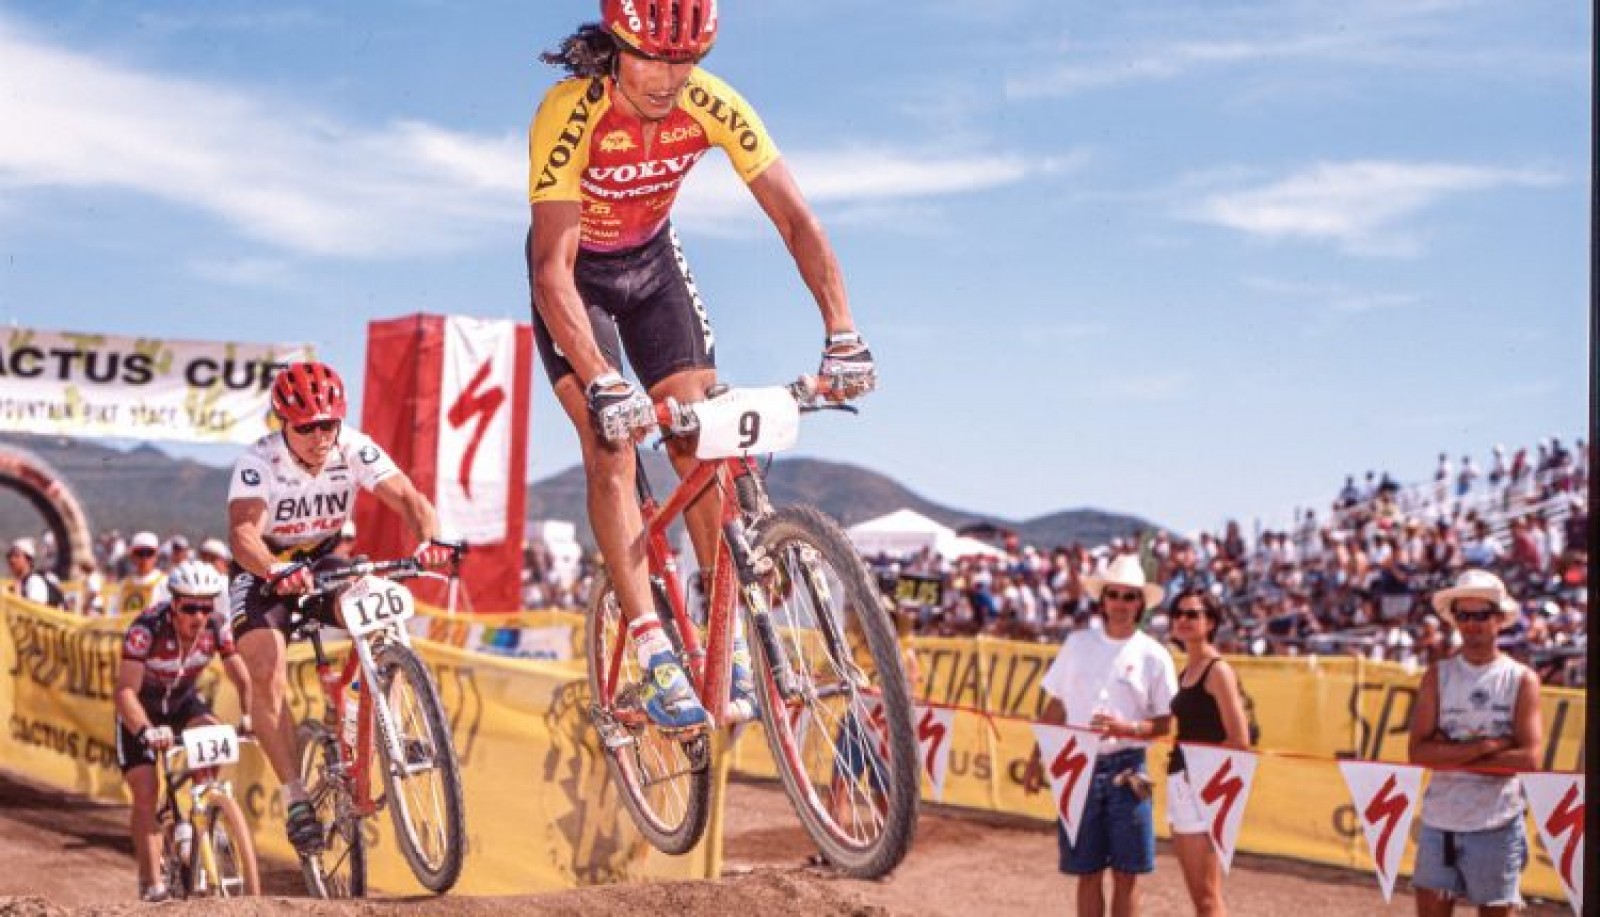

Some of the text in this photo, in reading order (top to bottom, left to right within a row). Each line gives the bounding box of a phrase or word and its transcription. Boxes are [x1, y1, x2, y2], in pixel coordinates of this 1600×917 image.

[685, 80, 757, 152] OLVO
[588, 153, 706, 182] VOLV
[738, 410, 760, 448] 9
[275, 491, 348, 521] BMW
[354, 587, 403, 626] 126
[196, 737, 231, 762] 134
